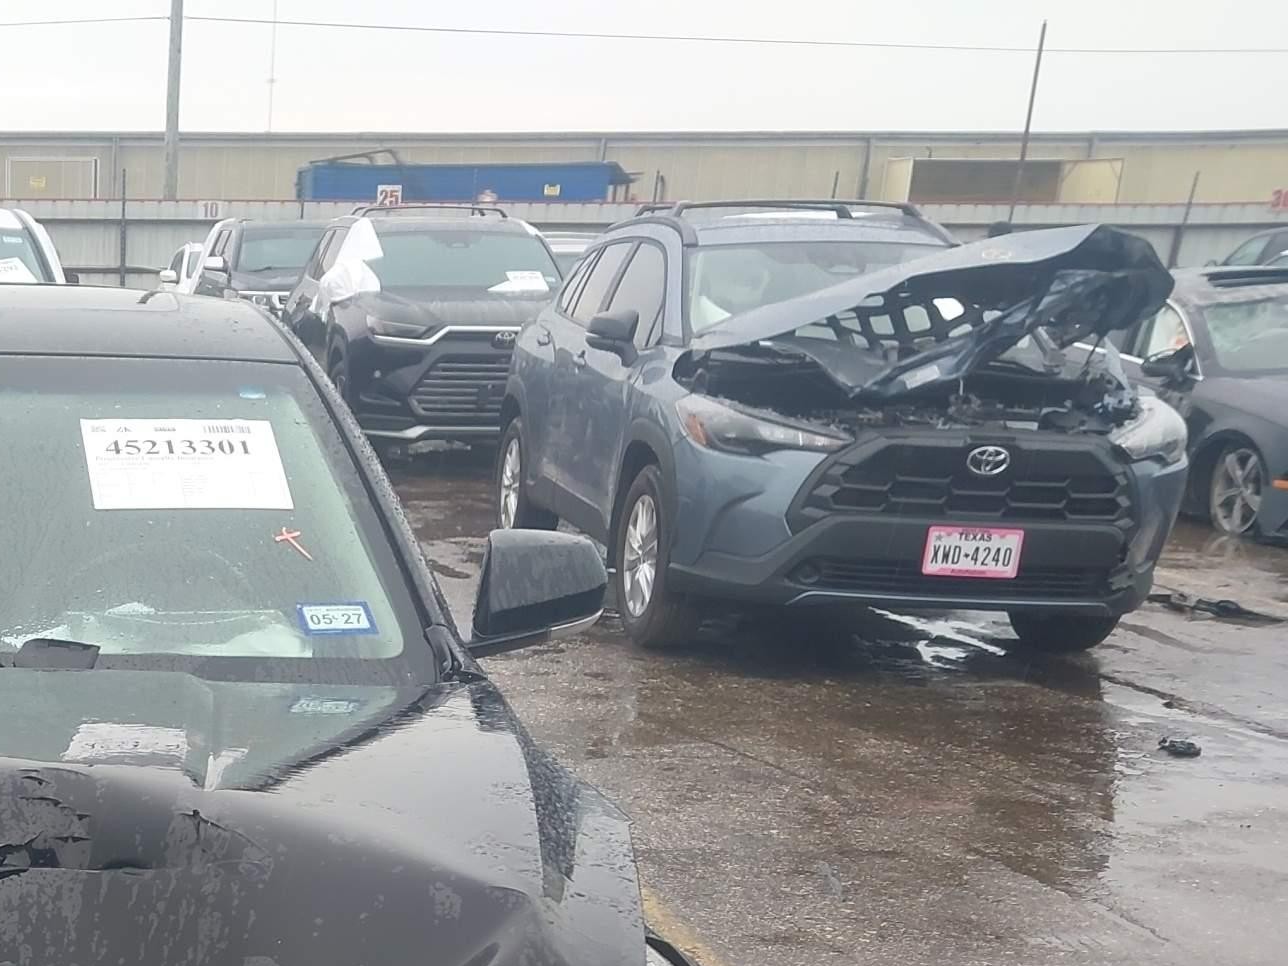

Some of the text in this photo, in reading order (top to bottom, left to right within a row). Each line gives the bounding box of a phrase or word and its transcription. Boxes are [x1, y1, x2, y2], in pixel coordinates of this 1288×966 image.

[379, 190, 399, 206] 25
[203, 202, 218, 218] 10
[105, 439, 250, 455] 45213301
[958, 533, 993, 542] TEXAS
